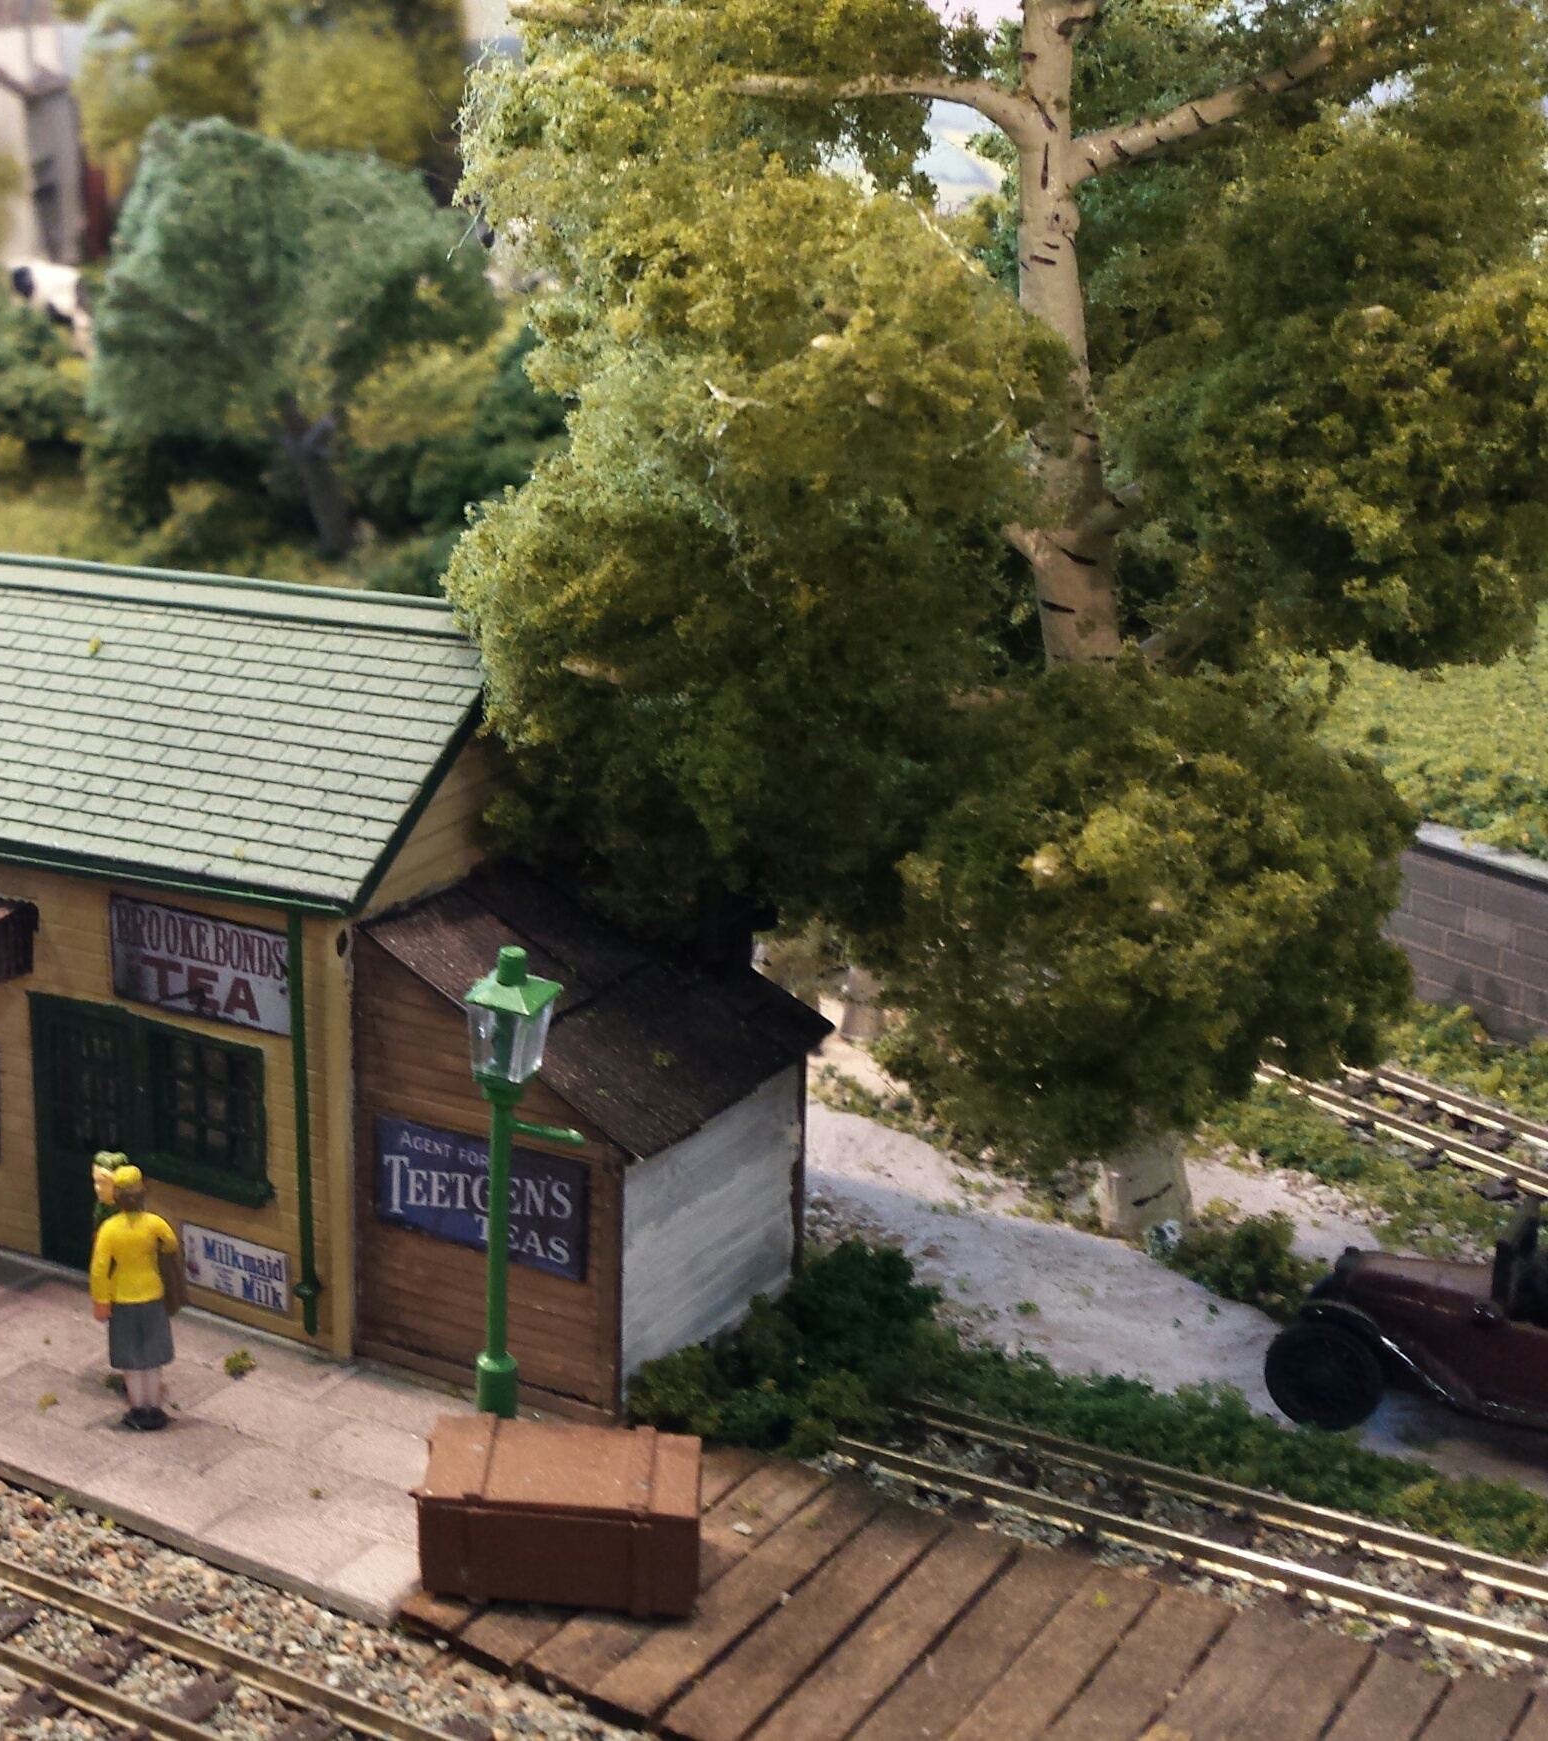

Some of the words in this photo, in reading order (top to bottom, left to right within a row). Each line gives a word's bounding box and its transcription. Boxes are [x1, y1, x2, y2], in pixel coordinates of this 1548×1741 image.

[140, 955, 260, 1022] TEA
[401, 1130, 452, 1158] AGENT
[203, 1236, 284, 1282] Milkmaid
[241, 1275, 283, 1309] Milk
